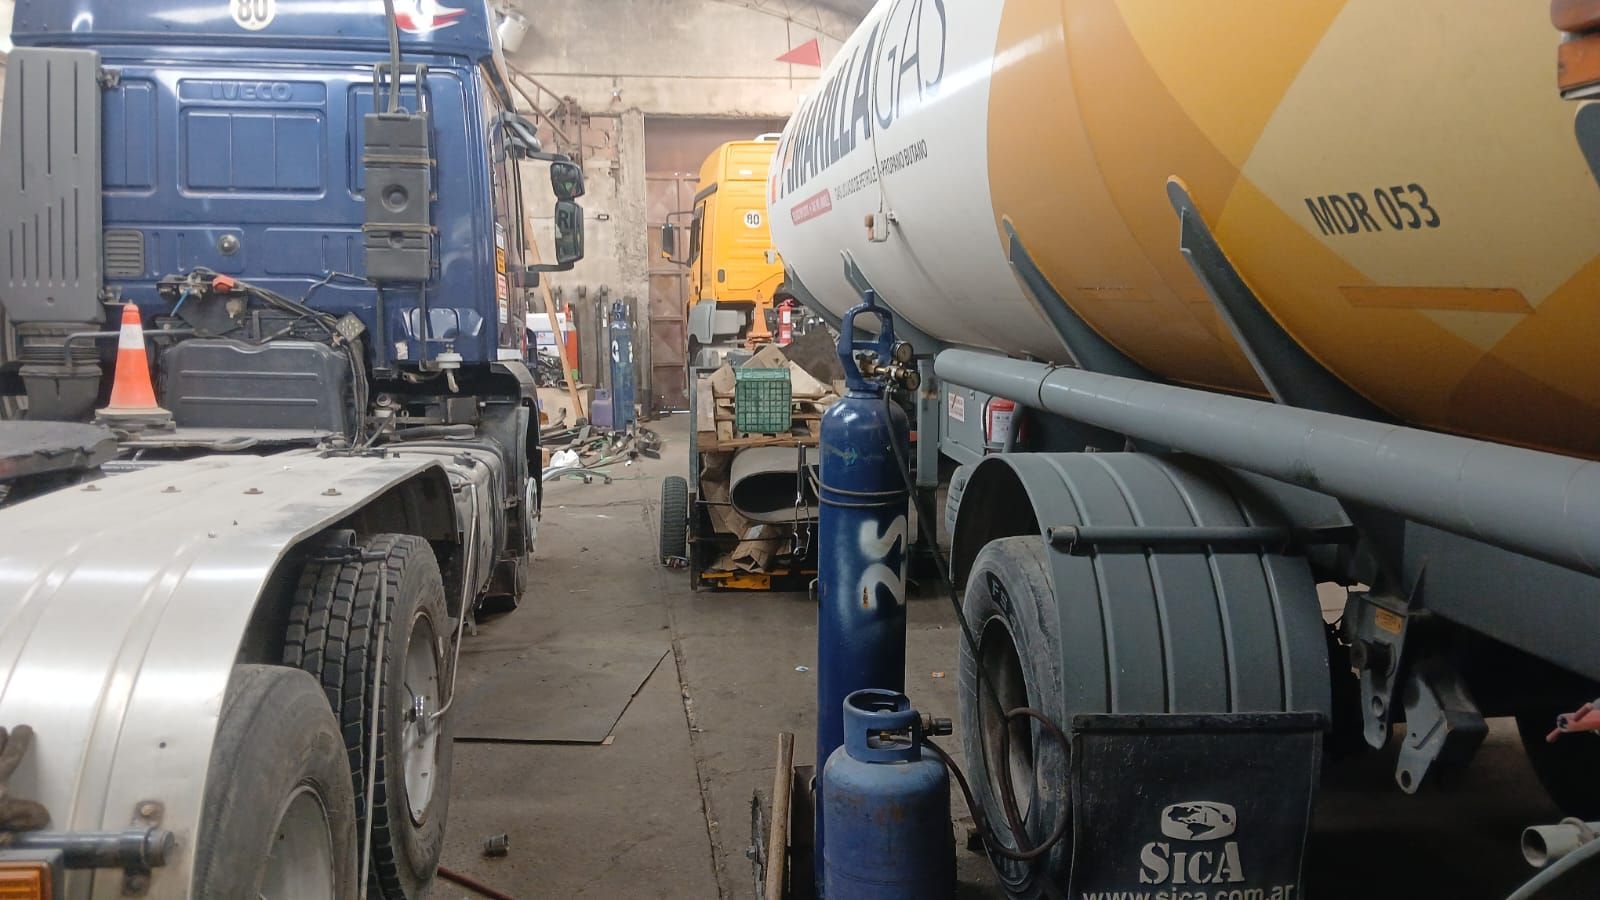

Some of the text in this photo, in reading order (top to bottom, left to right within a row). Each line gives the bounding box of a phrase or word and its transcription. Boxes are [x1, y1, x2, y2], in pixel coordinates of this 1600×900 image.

[237, 0, 268, 22] 80
[210, 81, 293, 101] IVECO
[881, 151, 905, 176] PROPANO
[902, 139, 928, 166] BUTANO
[1304, 183, 1440, 236] MDR 053
[1083, 884, 1294, 900] wwwsicacom.ar
